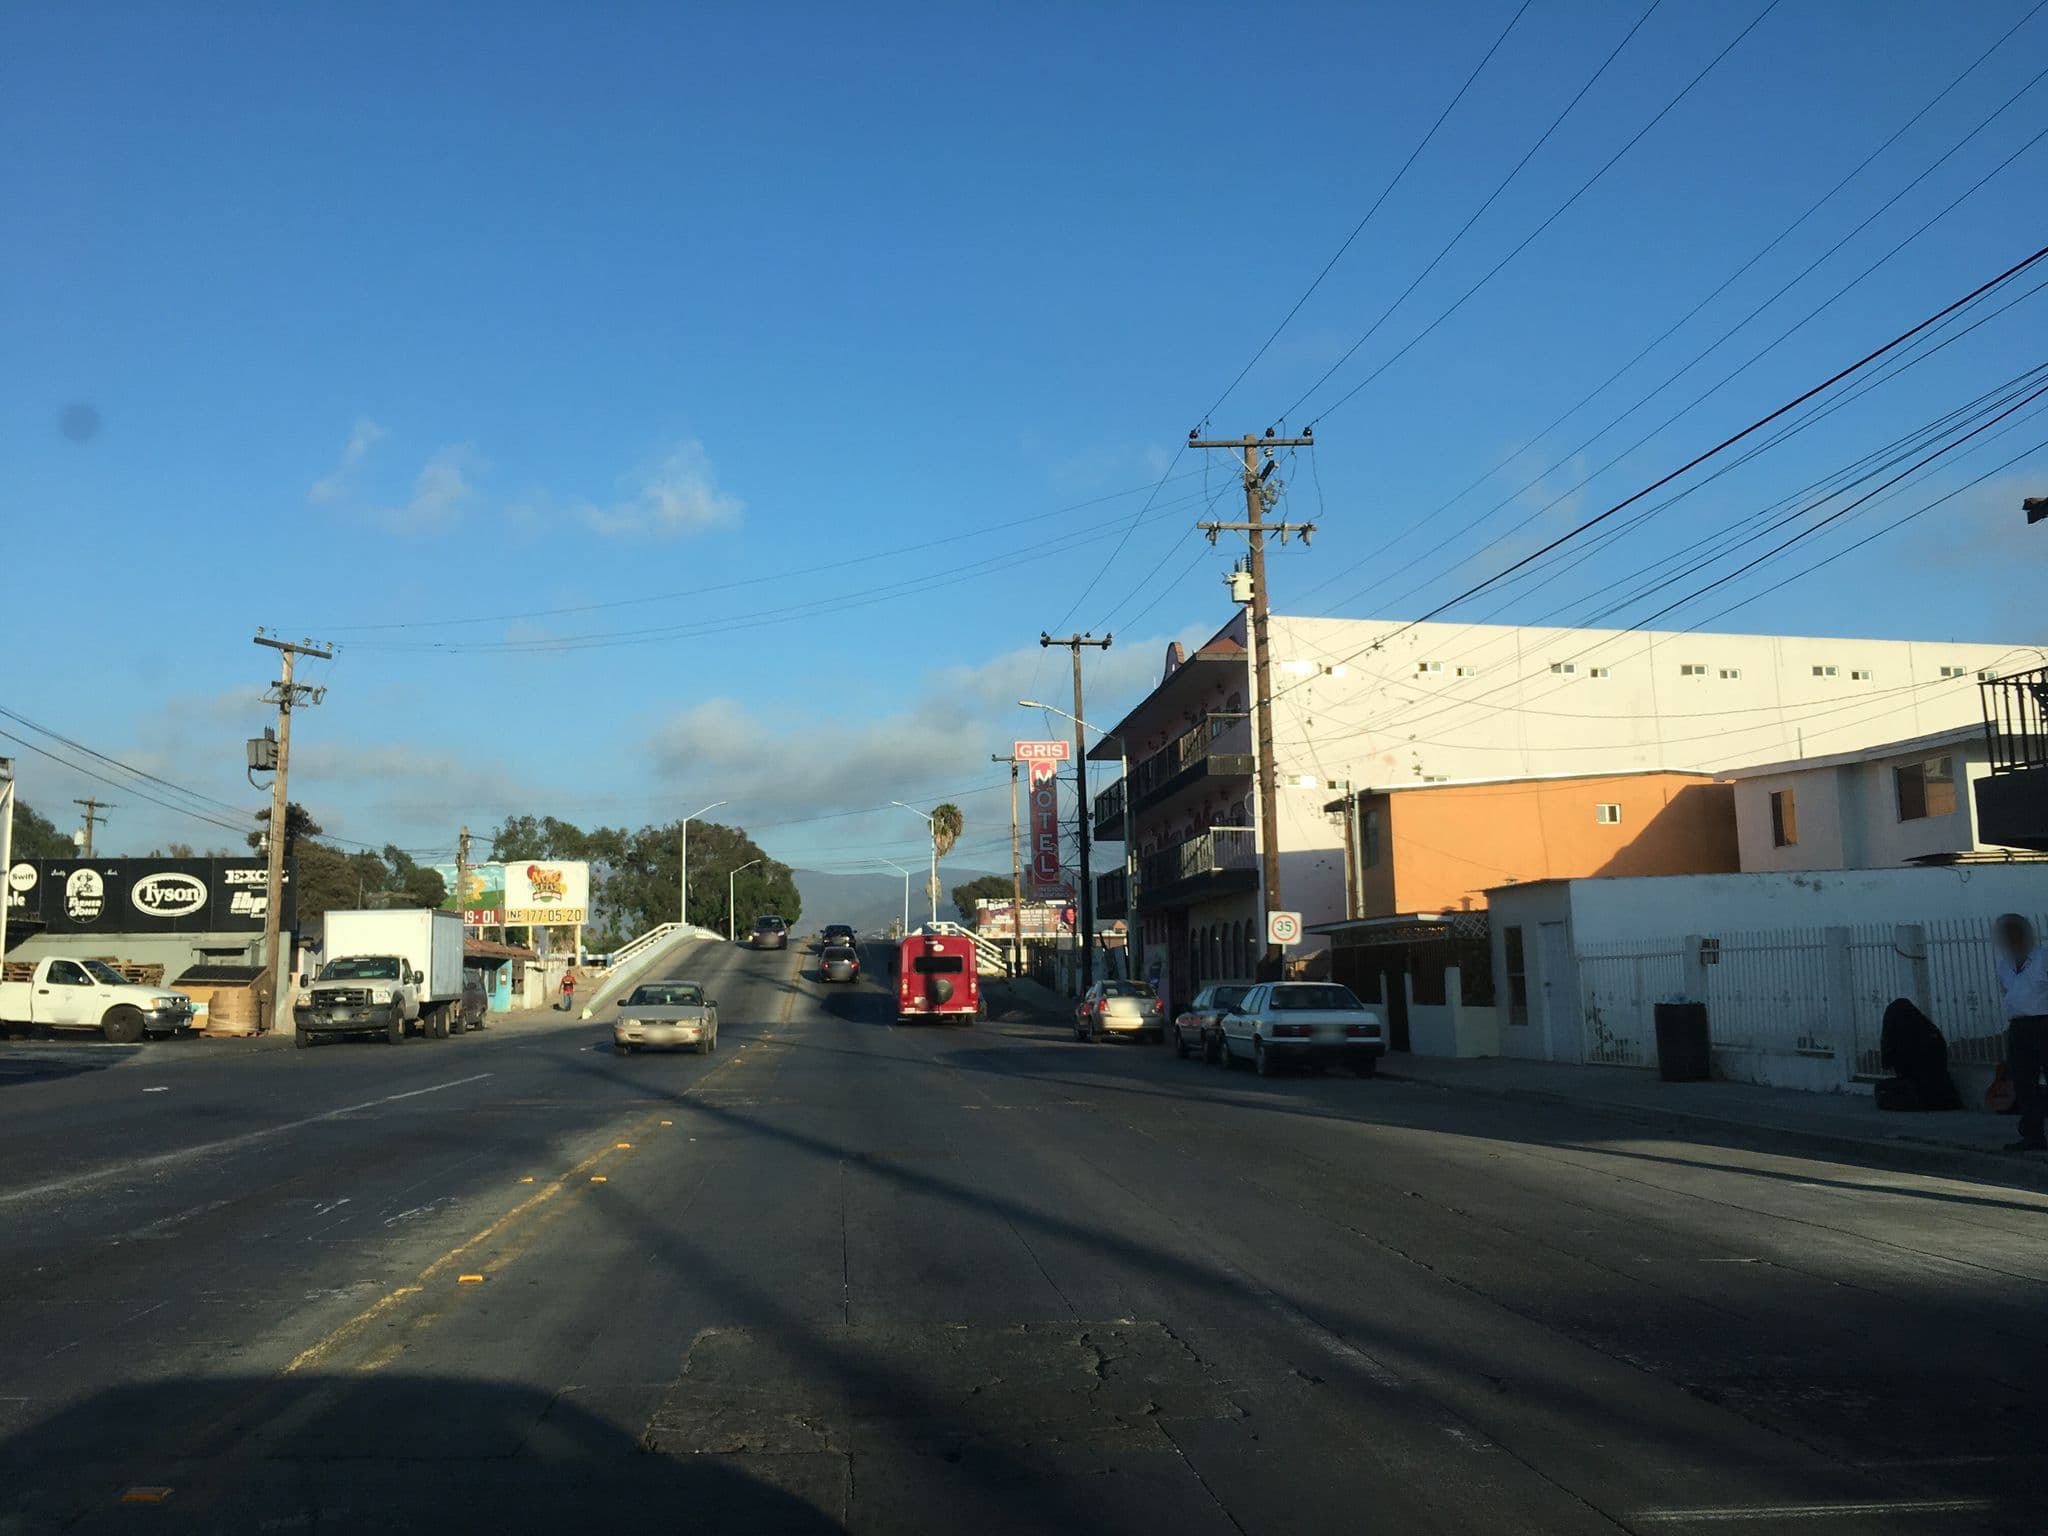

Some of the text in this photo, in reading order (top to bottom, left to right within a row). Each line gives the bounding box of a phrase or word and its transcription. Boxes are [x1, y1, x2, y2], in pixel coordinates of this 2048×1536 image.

[1019, 744, 1063, 757] GRIS
[1035, 769, 1055, 873] MOTEL
[12, 872, 34, 880] Swift
[144, 883, 199, 907] Tyson
[69, 906, 99, 917] JOHN
[1276, 920, 1292, 932] 35
